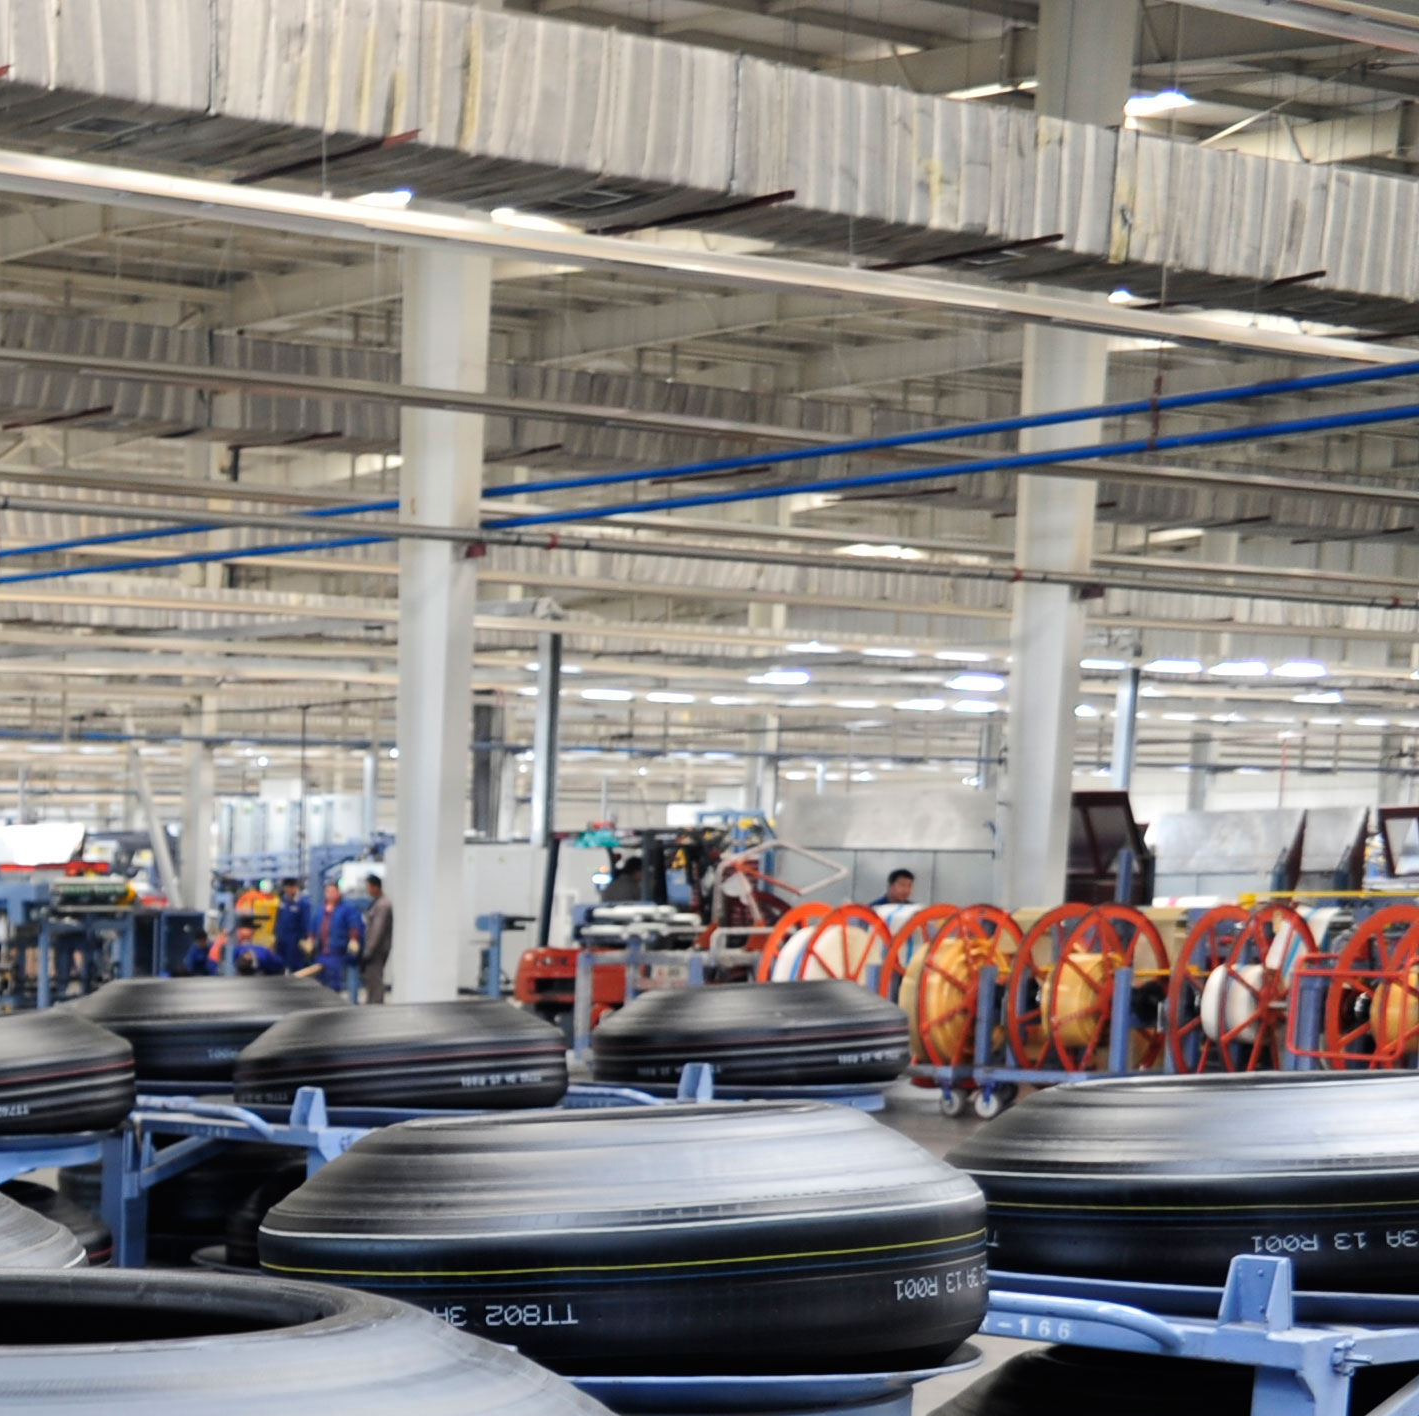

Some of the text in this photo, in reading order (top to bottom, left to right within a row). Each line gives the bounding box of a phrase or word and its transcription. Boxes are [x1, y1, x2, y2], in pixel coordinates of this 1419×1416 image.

[1251, 1229, 1419, 1254] 3A 13 R001
[893, 1274, 939, 1301] R001
[945, 1270, 962, 1295] 13
[485, 1303, 579, 1326] TT802
